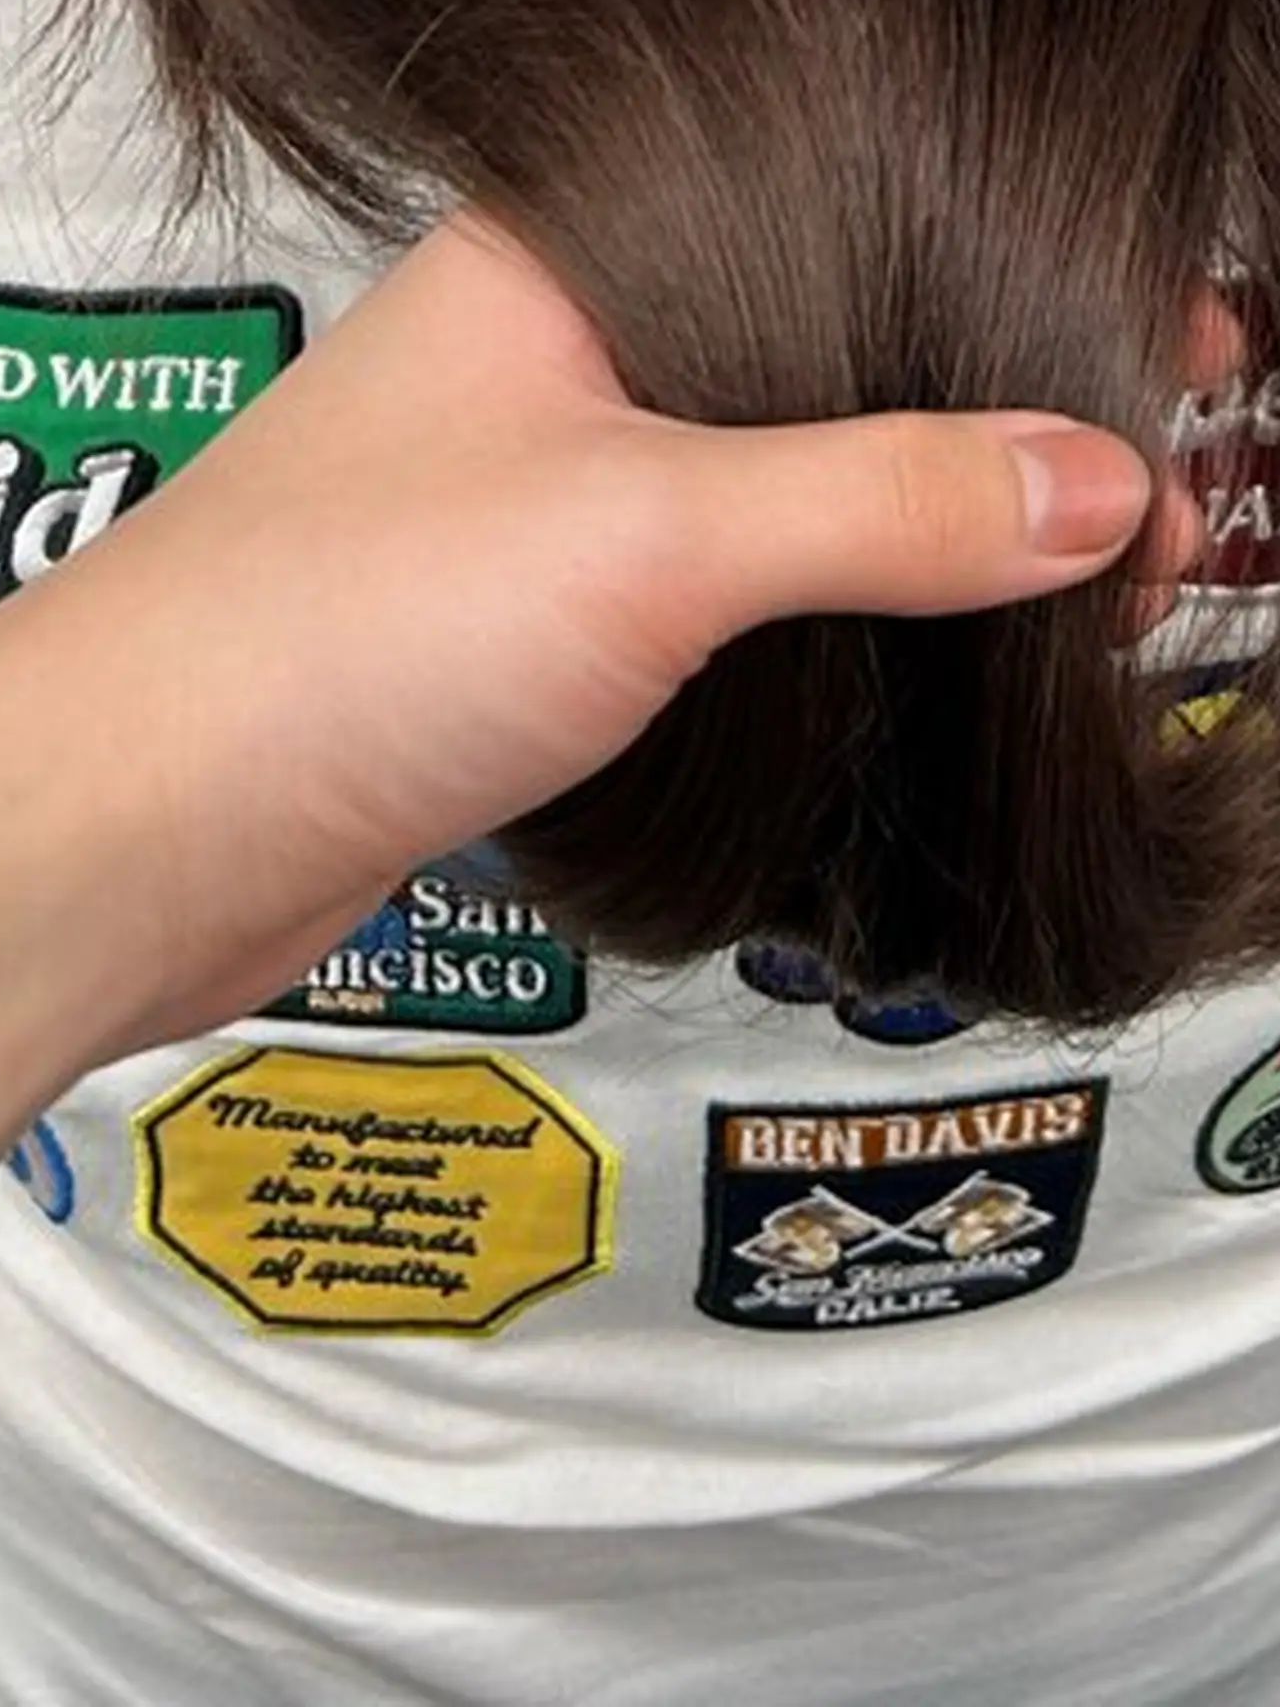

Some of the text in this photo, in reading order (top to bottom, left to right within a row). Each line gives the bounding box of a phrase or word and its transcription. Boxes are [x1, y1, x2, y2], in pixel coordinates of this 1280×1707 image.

[49, 354, 242, 413] WITH
[408, 875, 549, 936] San
[306, 936, 548, 1003] ncisco
[208, 1094, 543, 1146] Manufactured
[738, 1091, 1089, 1171] BEN DAVIS
[289, 1143, 446, 1179] to meet
[247, 1175, 489, 1227] the highest
[247, 1215, 477, 1256] standards
[248, 1247, 305, 1287] of
